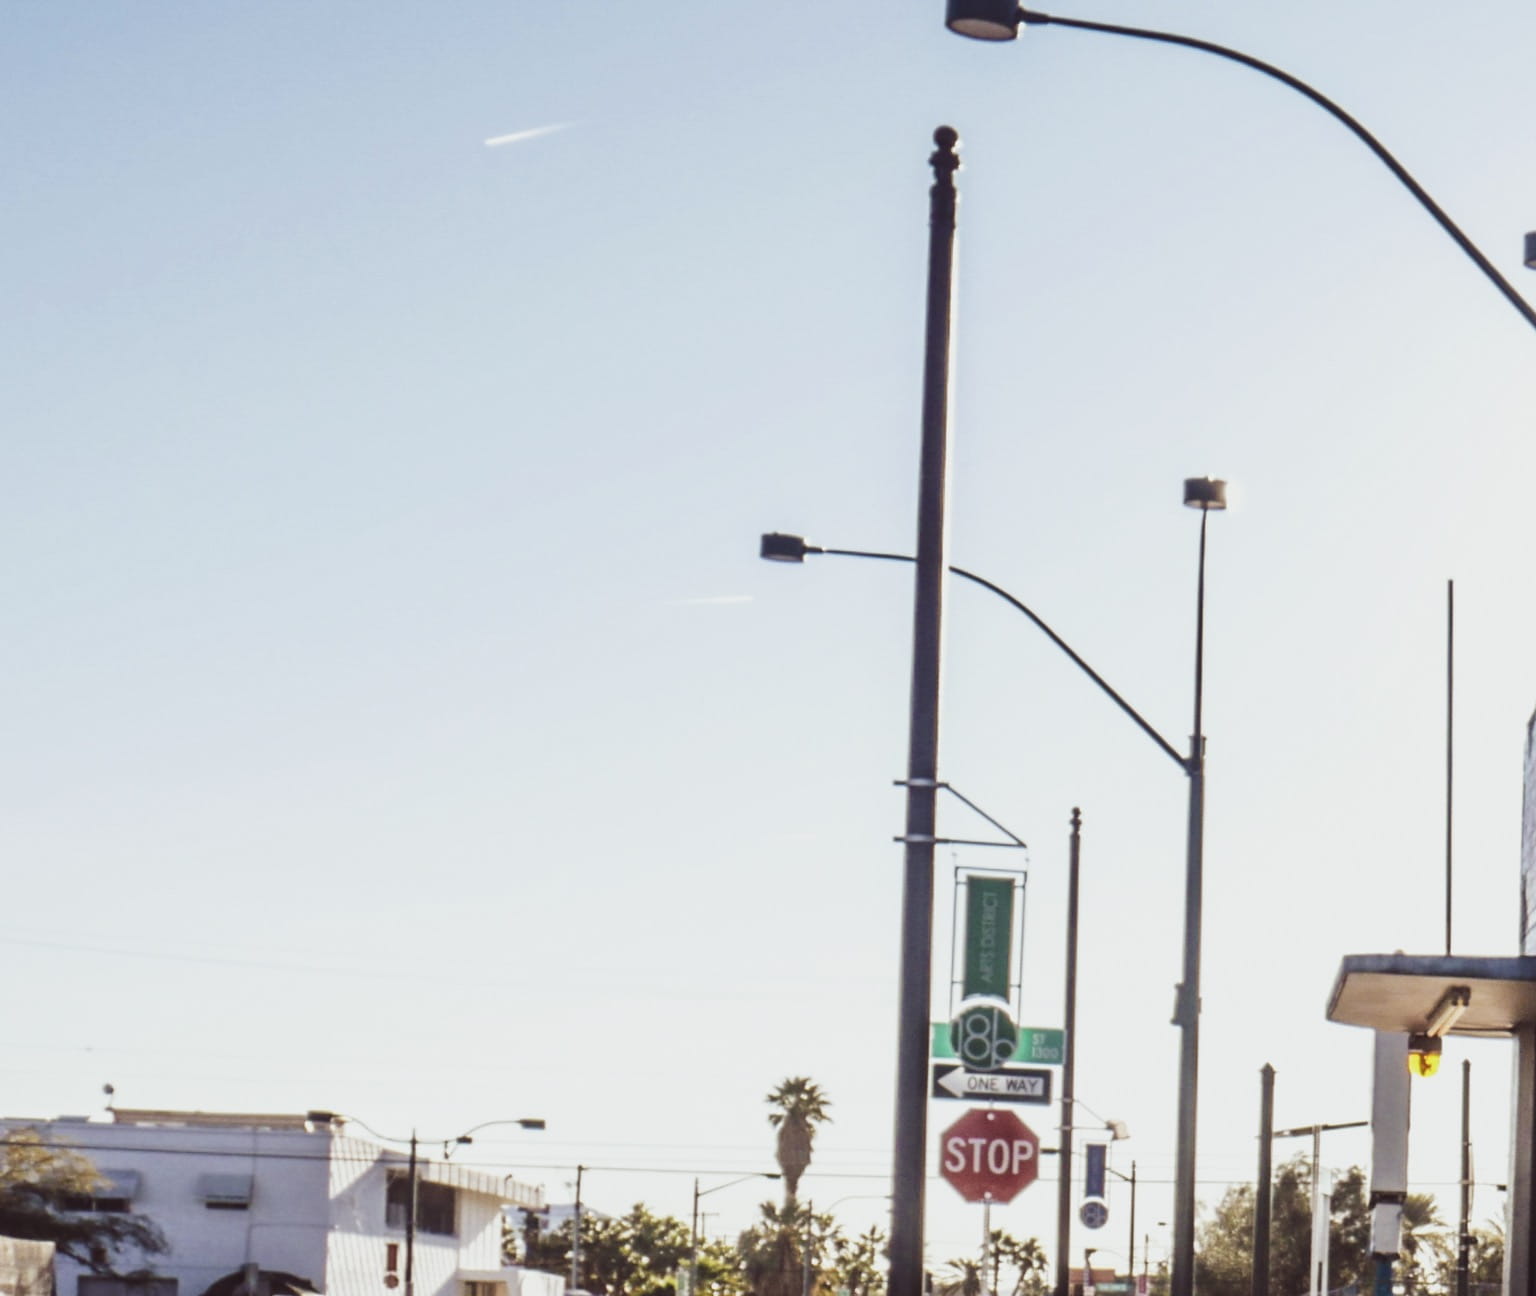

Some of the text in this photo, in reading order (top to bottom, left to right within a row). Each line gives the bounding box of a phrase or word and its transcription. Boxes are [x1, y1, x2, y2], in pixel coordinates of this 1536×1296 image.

[980, 892, 998, 984] ARTS DISTRICT
[1032, 1033, 1045, 1046] ST
[967, 1076, 1039, 1093] ONE WAY
[945, 1136, 1034, 1175] STOP
